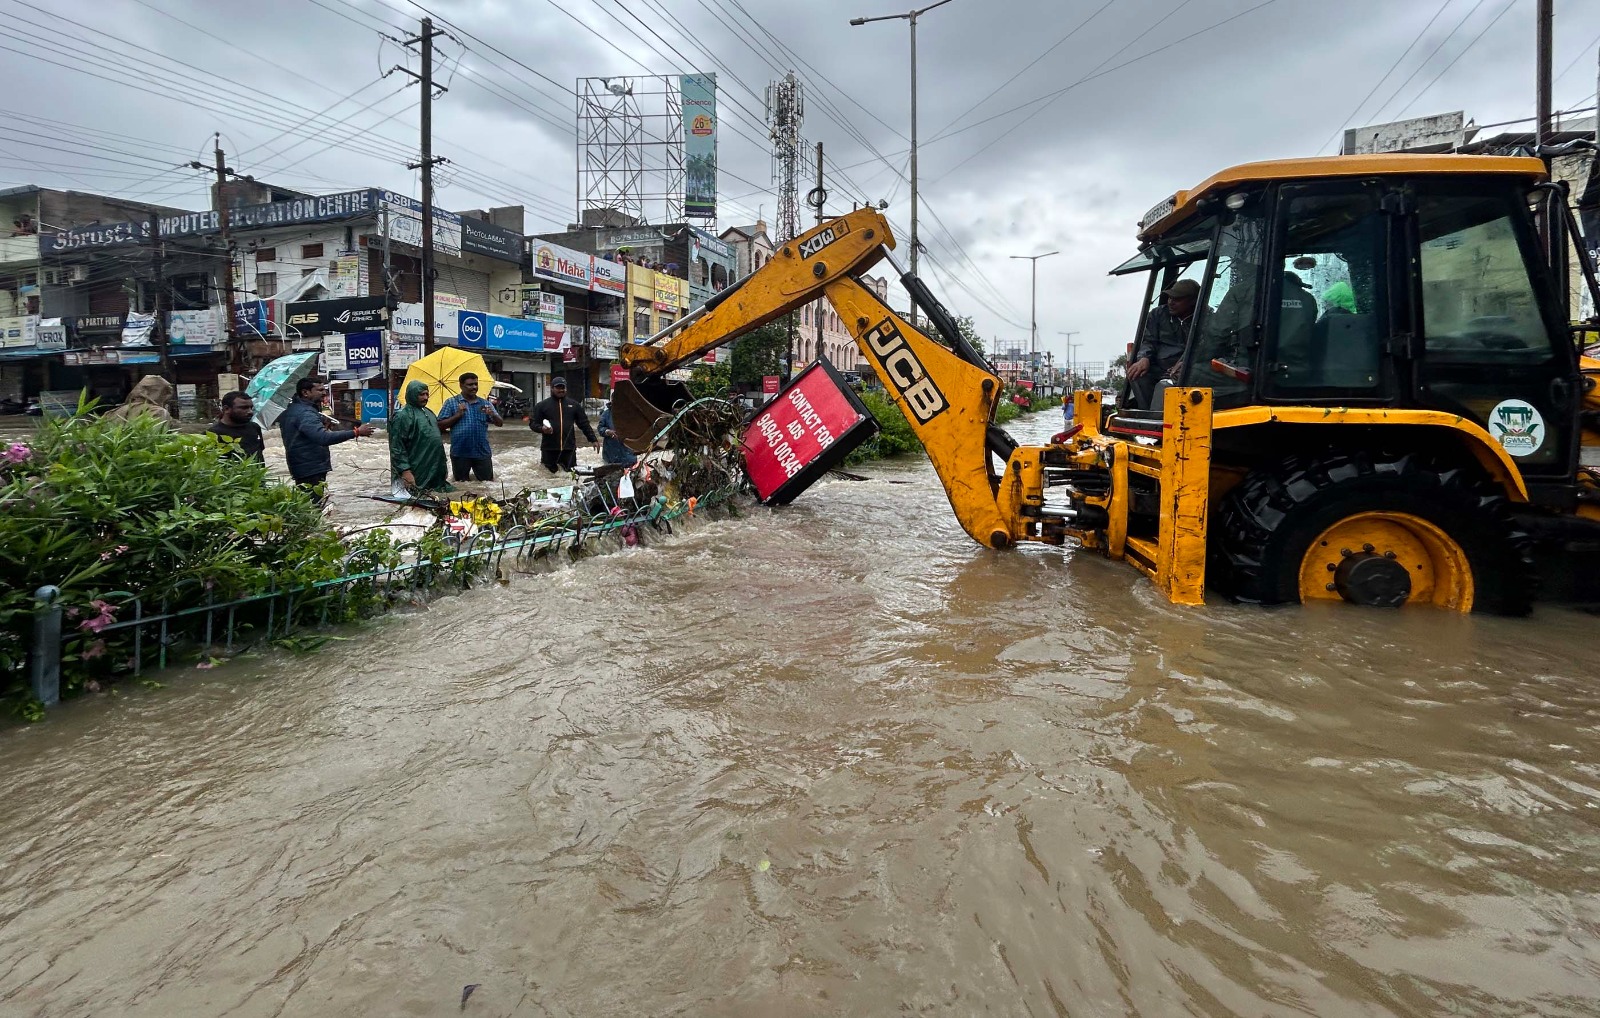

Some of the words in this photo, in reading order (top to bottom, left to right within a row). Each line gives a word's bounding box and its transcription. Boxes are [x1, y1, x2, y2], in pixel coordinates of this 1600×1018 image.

[694, 117, 705, 129] 26
[393, 193, 411, 208] SBI
[52, 222, 134, 250] Shrusti
[141, 211, 219, 238] CMPUTER
[318, 191, 369, 217] CENTRE
[557, 257, 585, 279] Maha
[595, 266, 611, 277] ADS
[85, 317, 104, 326] PARTY
[288, 313, 319, 324] ASUS
[396, 316, 412, 326] Dell
[414, 319, 444, 329] Reler
[38, 331, 63, 343] XEROX
[348, 346, 379, 360] EPSON
[868, 329, 943, 421] JCB
[788, 388, 823, 430] CONTACT
[813, 425, 835, 449] FOR
[786, 419, 805, 440] ADS
[756, 413, 784, 448] 94943
[773, 441, 803, 478] 00345
[1505, 436, 1531, 444] GWMC
